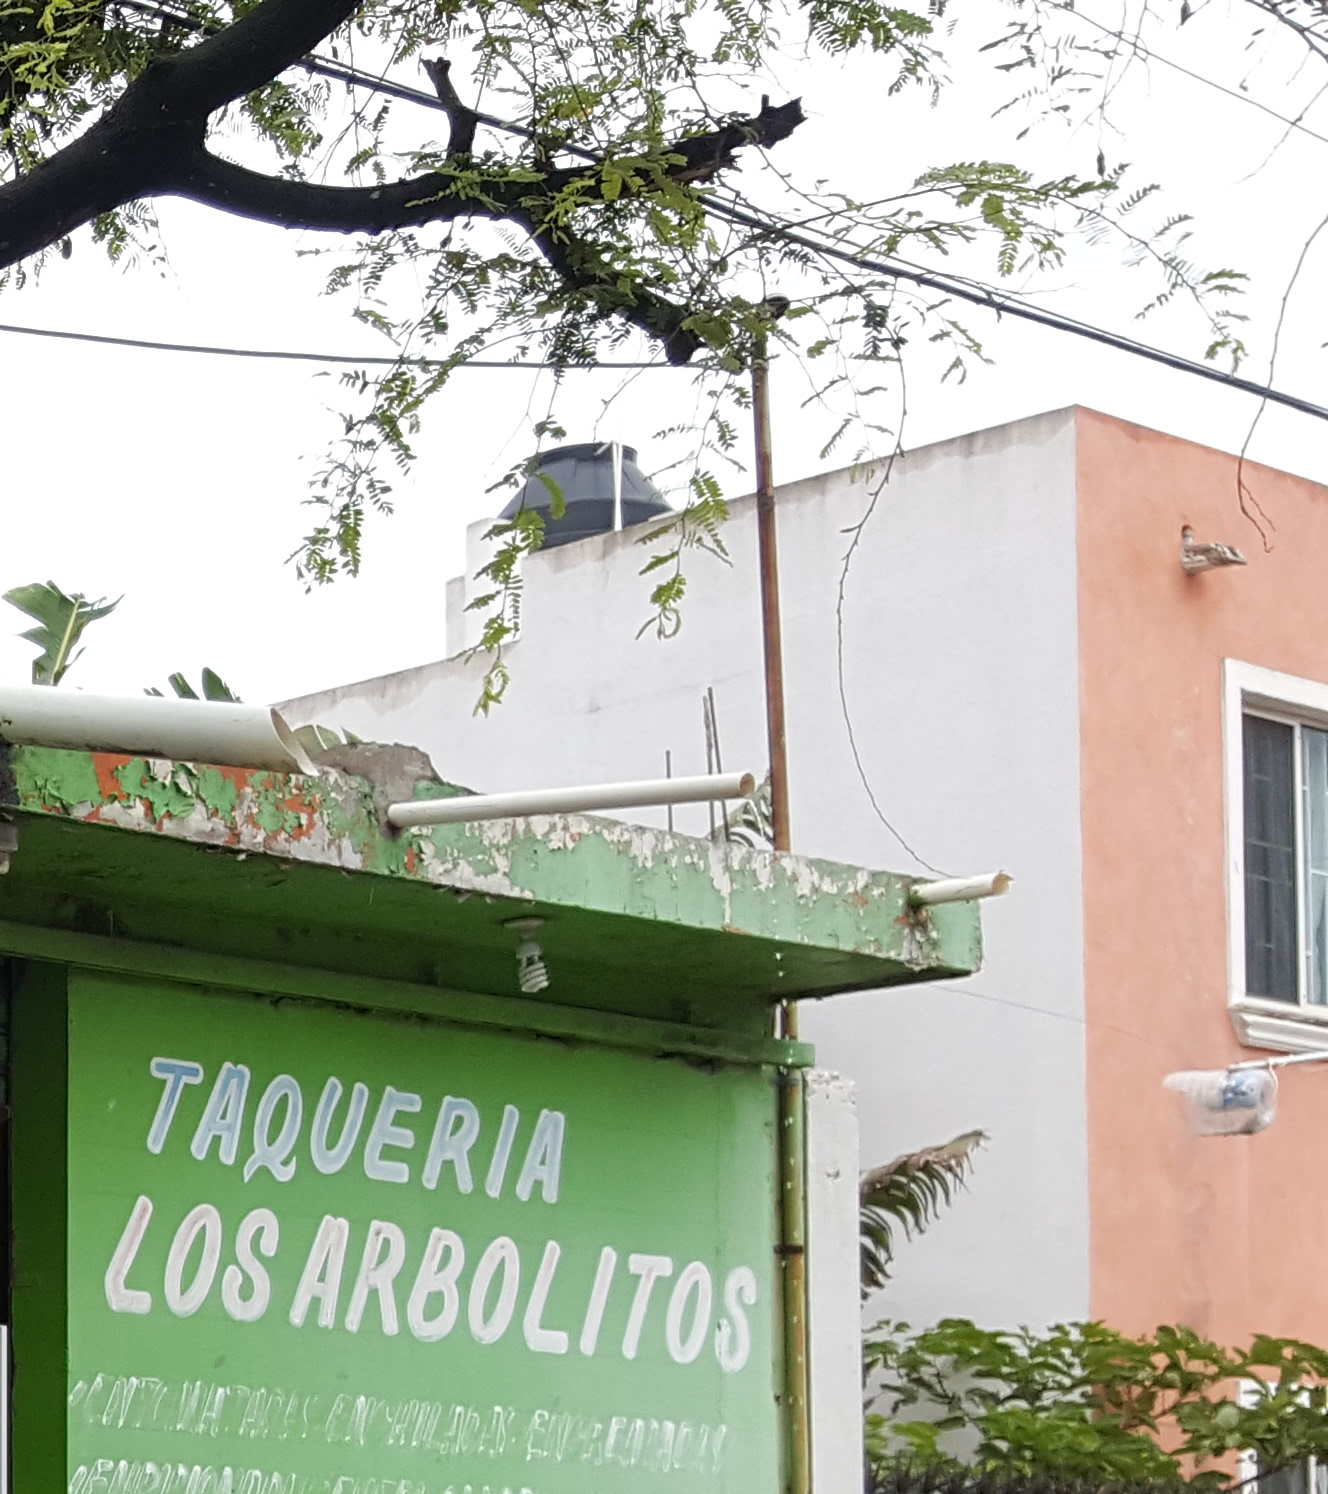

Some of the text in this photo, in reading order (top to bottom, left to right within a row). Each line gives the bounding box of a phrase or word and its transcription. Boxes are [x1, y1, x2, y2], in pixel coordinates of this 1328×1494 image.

[147, 1056, 566, 1205] TAQUERIA
[104, 1195, 758, 1373] LOS ARBOLITOS
